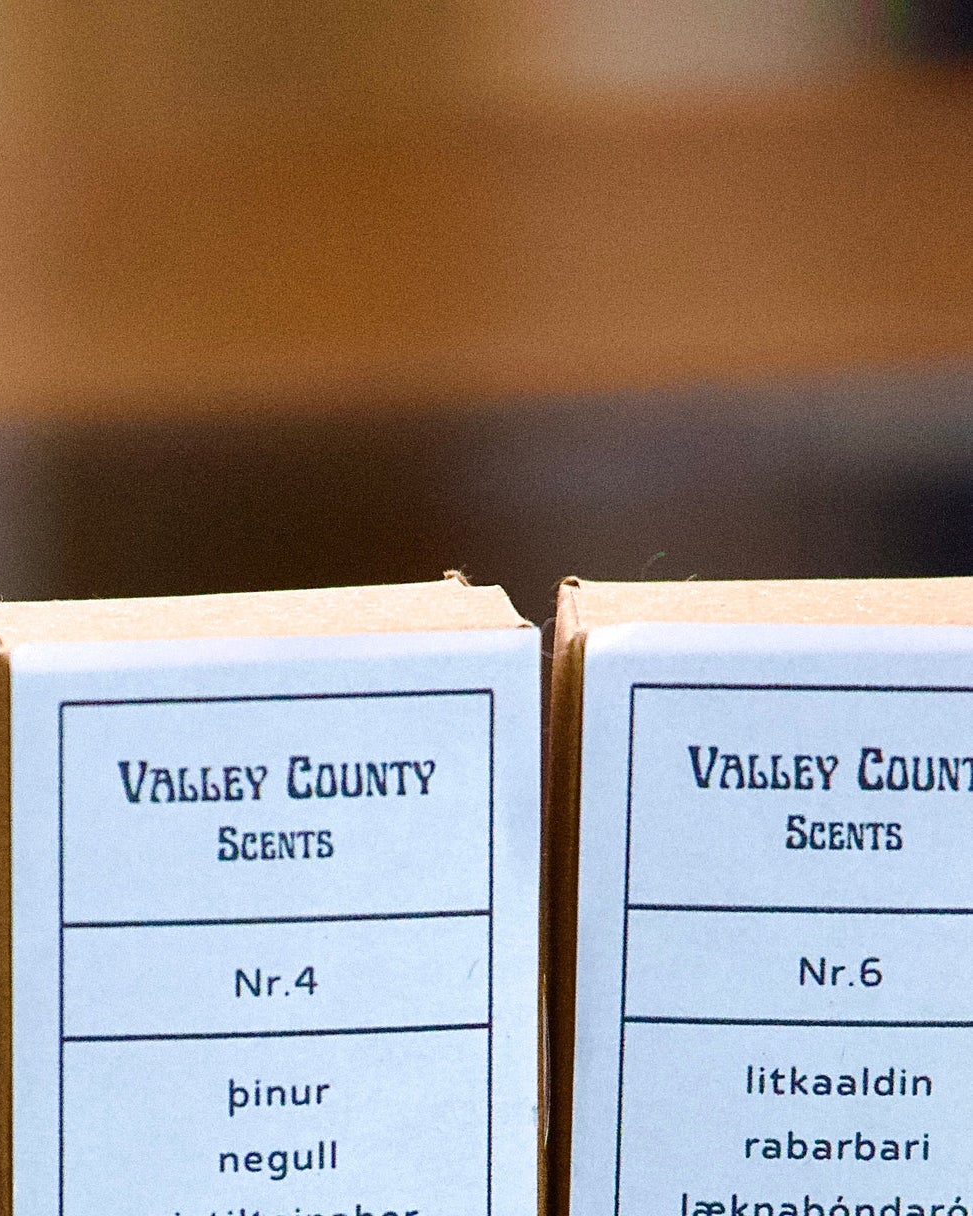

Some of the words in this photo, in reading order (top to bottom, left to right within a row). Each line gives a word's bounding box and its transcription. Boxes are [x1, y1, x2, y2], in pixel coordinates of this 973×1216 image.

[117, 760, 268, 804] VALLEY
[287, 755, 436, 800] COUNTY
[687, 745, 839, 791] VALLEY
[217, 825, 334, 862] SCENTS
[785, 814, 903, 851] SCENTS
[235, 966, 318, 998] Nr.4
[799, 956, 883, 988] Nr.6
[228, 1078, 330, 1117] þinur
[746, 1065, 932, 1097] litkaaldin
[219, 1140, 337, 1182] negull
[745, 1130, 930, 1162] rabarbari
